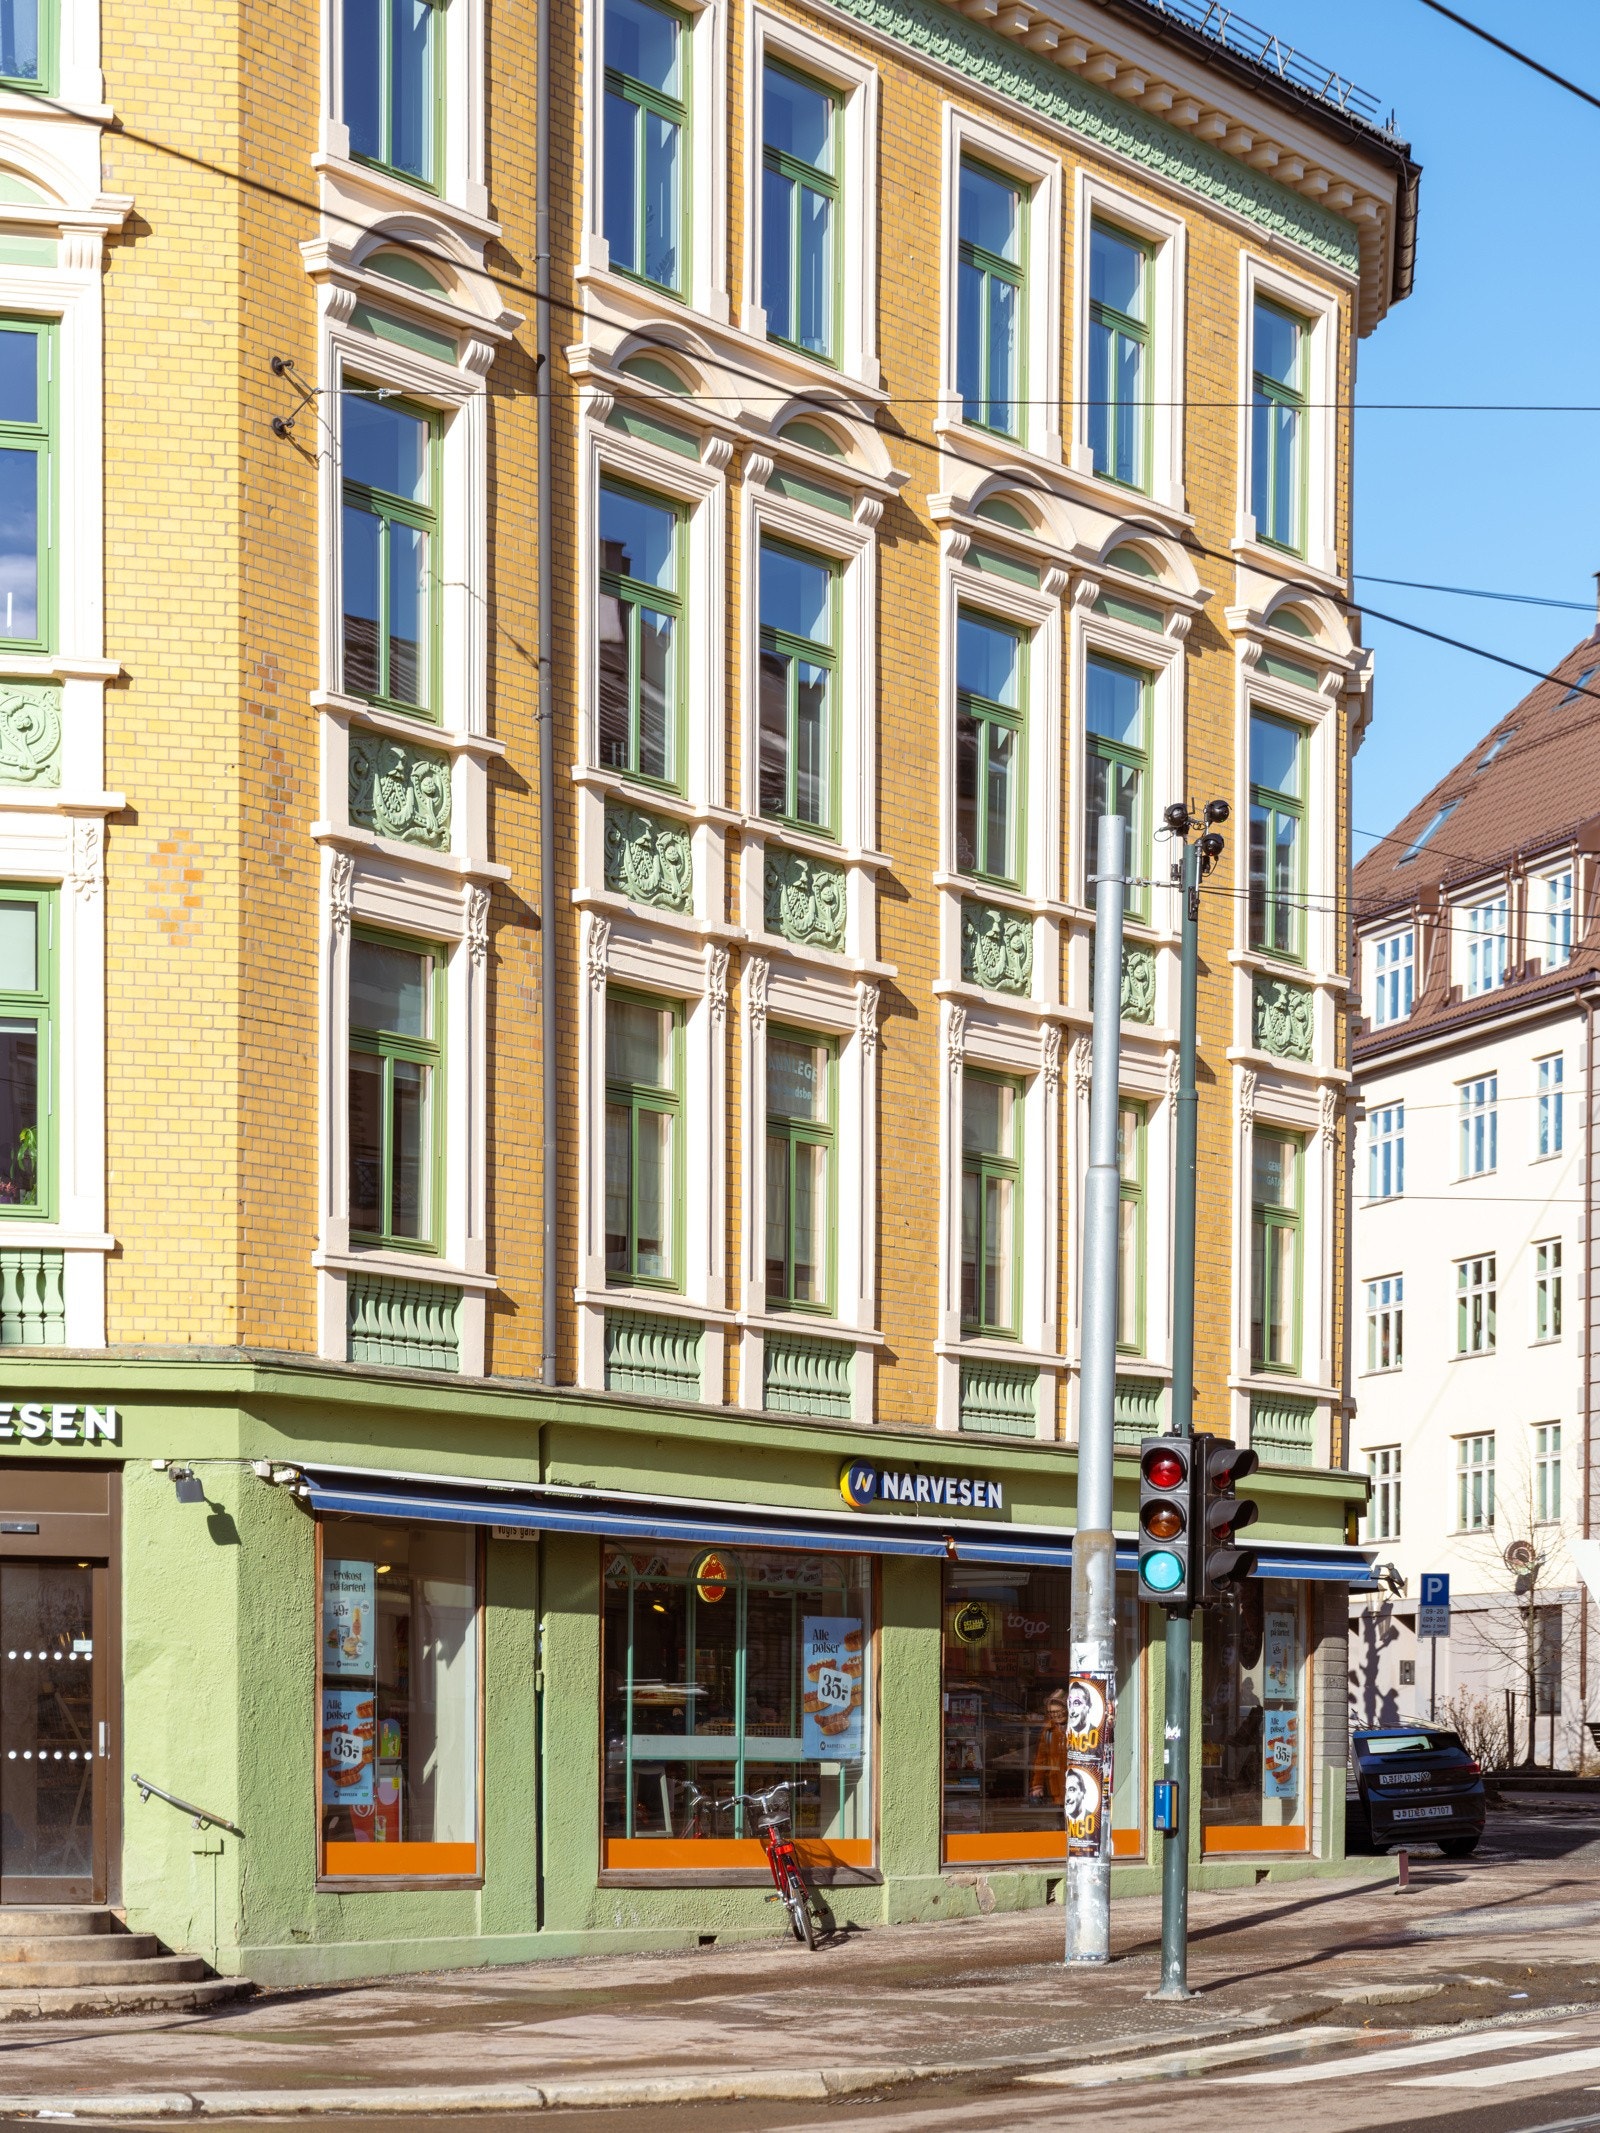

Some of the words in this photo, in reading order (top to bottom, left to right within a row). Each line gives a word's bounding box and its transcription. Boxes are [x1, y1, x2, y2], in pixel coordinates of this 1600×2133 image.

[882, 1471, 1003, 1509] NARVESEN
[333, 1569, 362, 1581] Frokost
[1427, 1578, 1443, 1602] P
[812, 1629, 829, 1641] Alle
[326, 1699, 343, 1710] Alle
